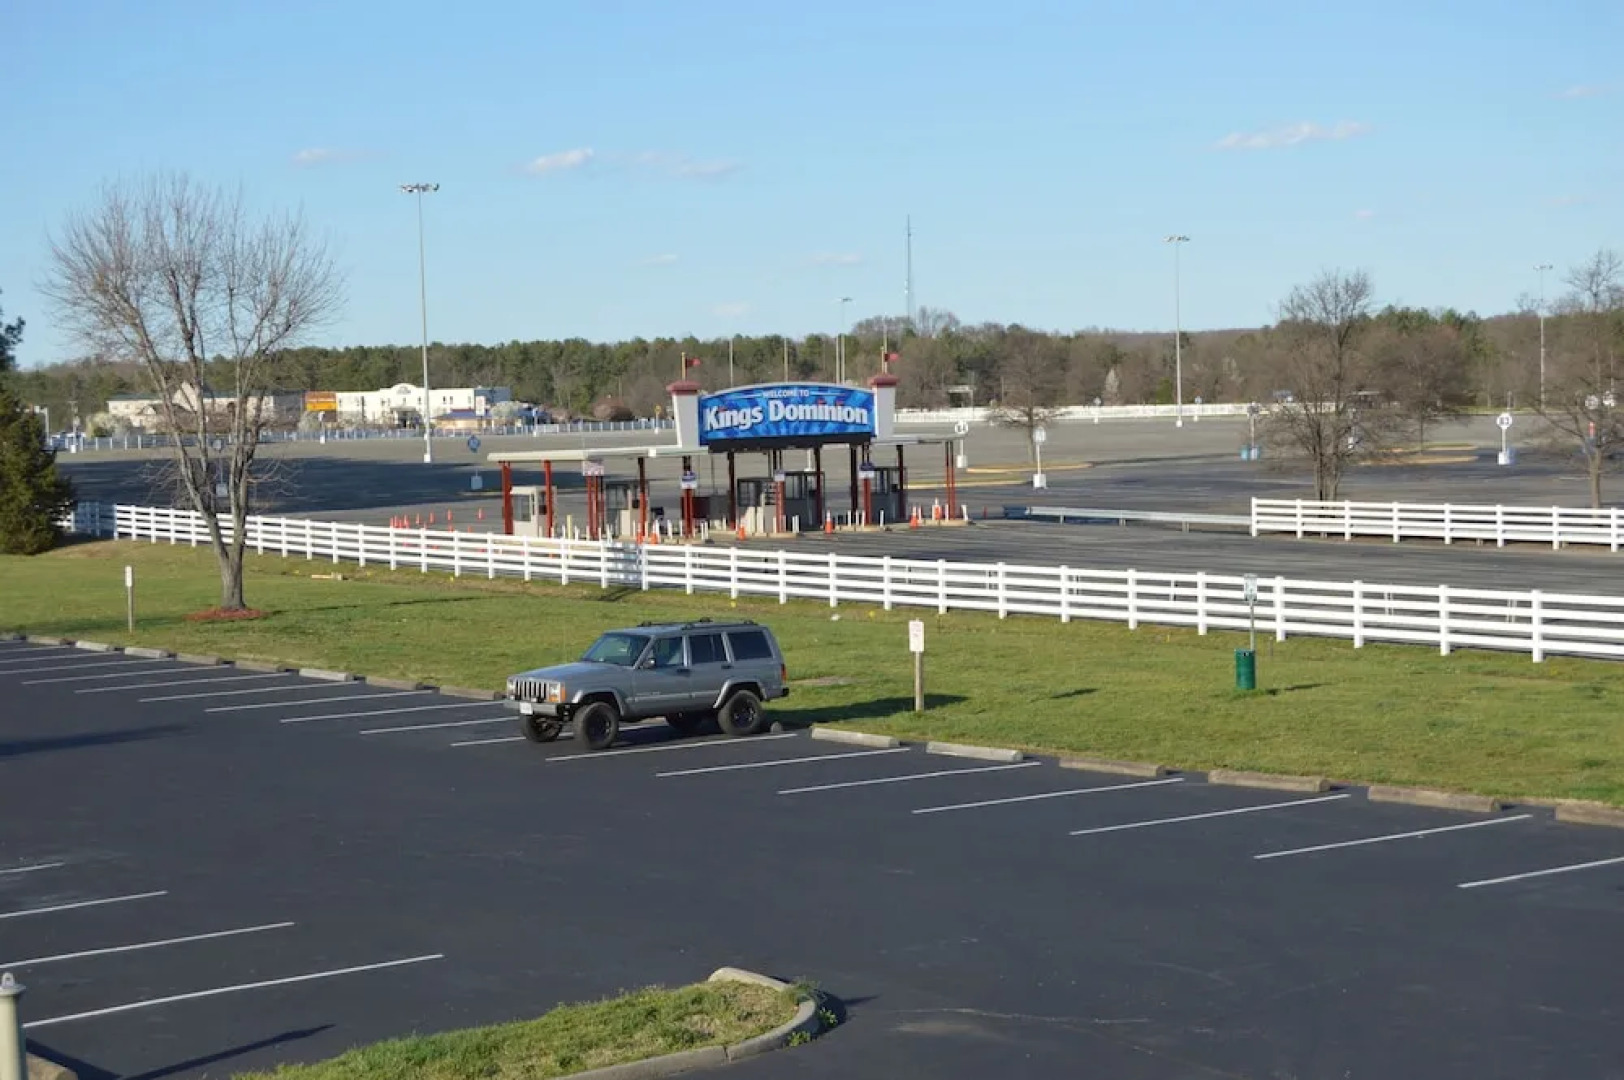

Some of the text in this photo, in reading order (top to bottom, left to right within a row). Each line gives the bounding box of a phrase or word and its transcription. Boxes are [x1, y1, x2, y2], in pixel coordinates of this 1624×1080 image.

[762, 389, 810, 398] WELCOME TO
[705, 399, 868, 430] Kings Dominion
